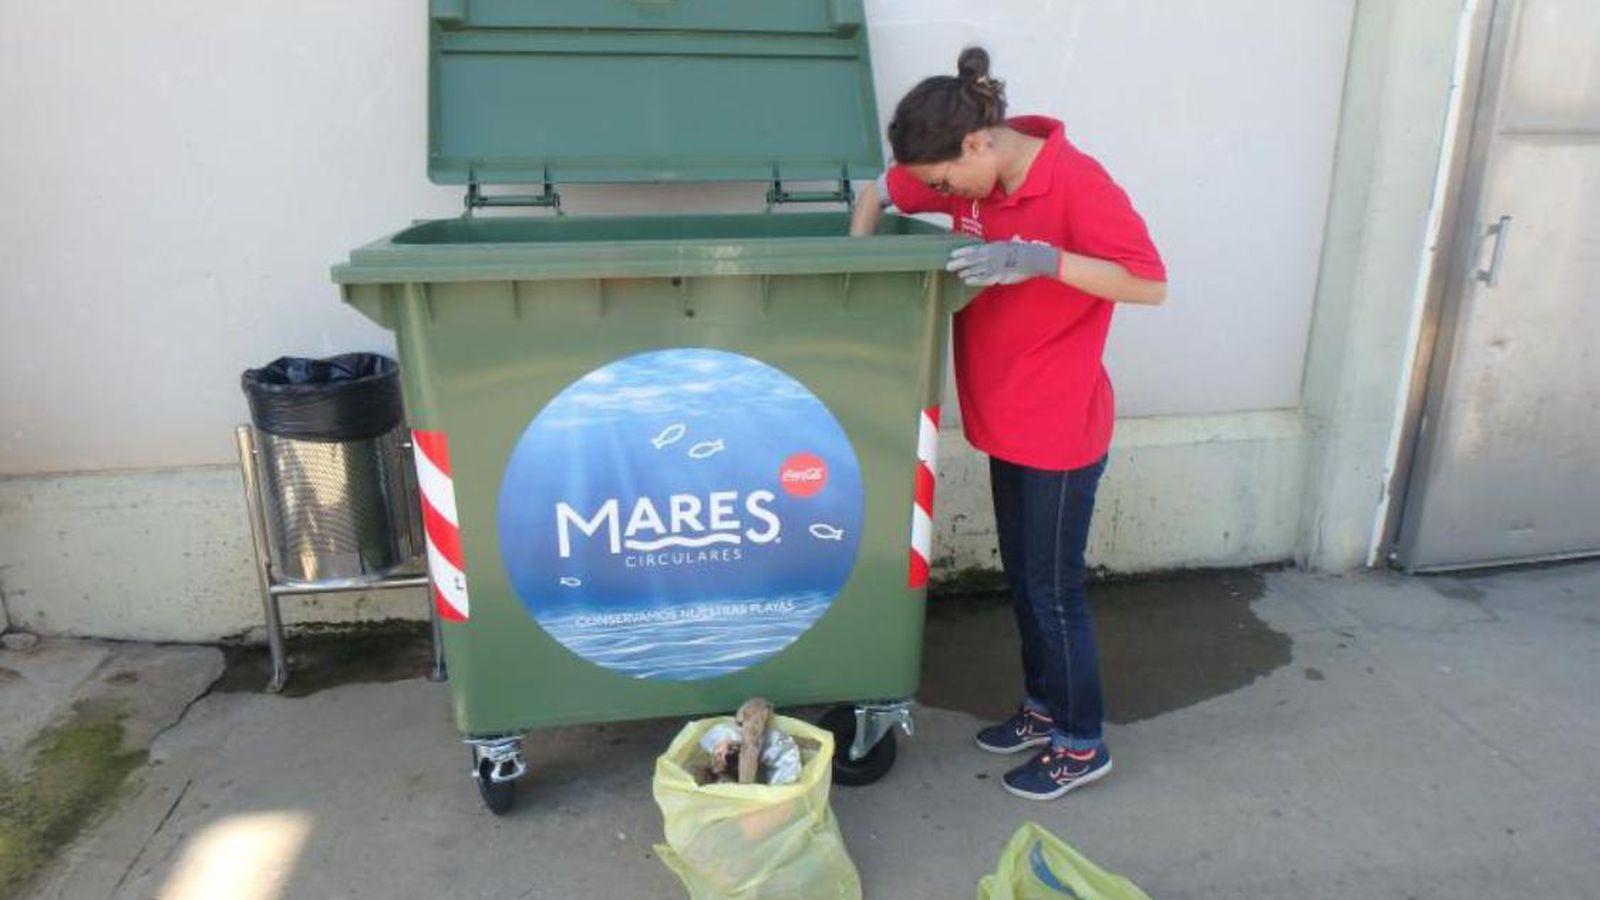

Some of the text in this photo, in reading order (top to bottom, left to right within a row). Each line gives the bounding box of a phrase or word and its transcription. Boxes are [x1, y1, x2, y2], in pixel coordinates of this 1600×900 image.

[556, 489, 781, 557] MARES
[625, 548, 741, 567] CIRCULARES
[575, 608, 675, 627] CONSERVAMOS
